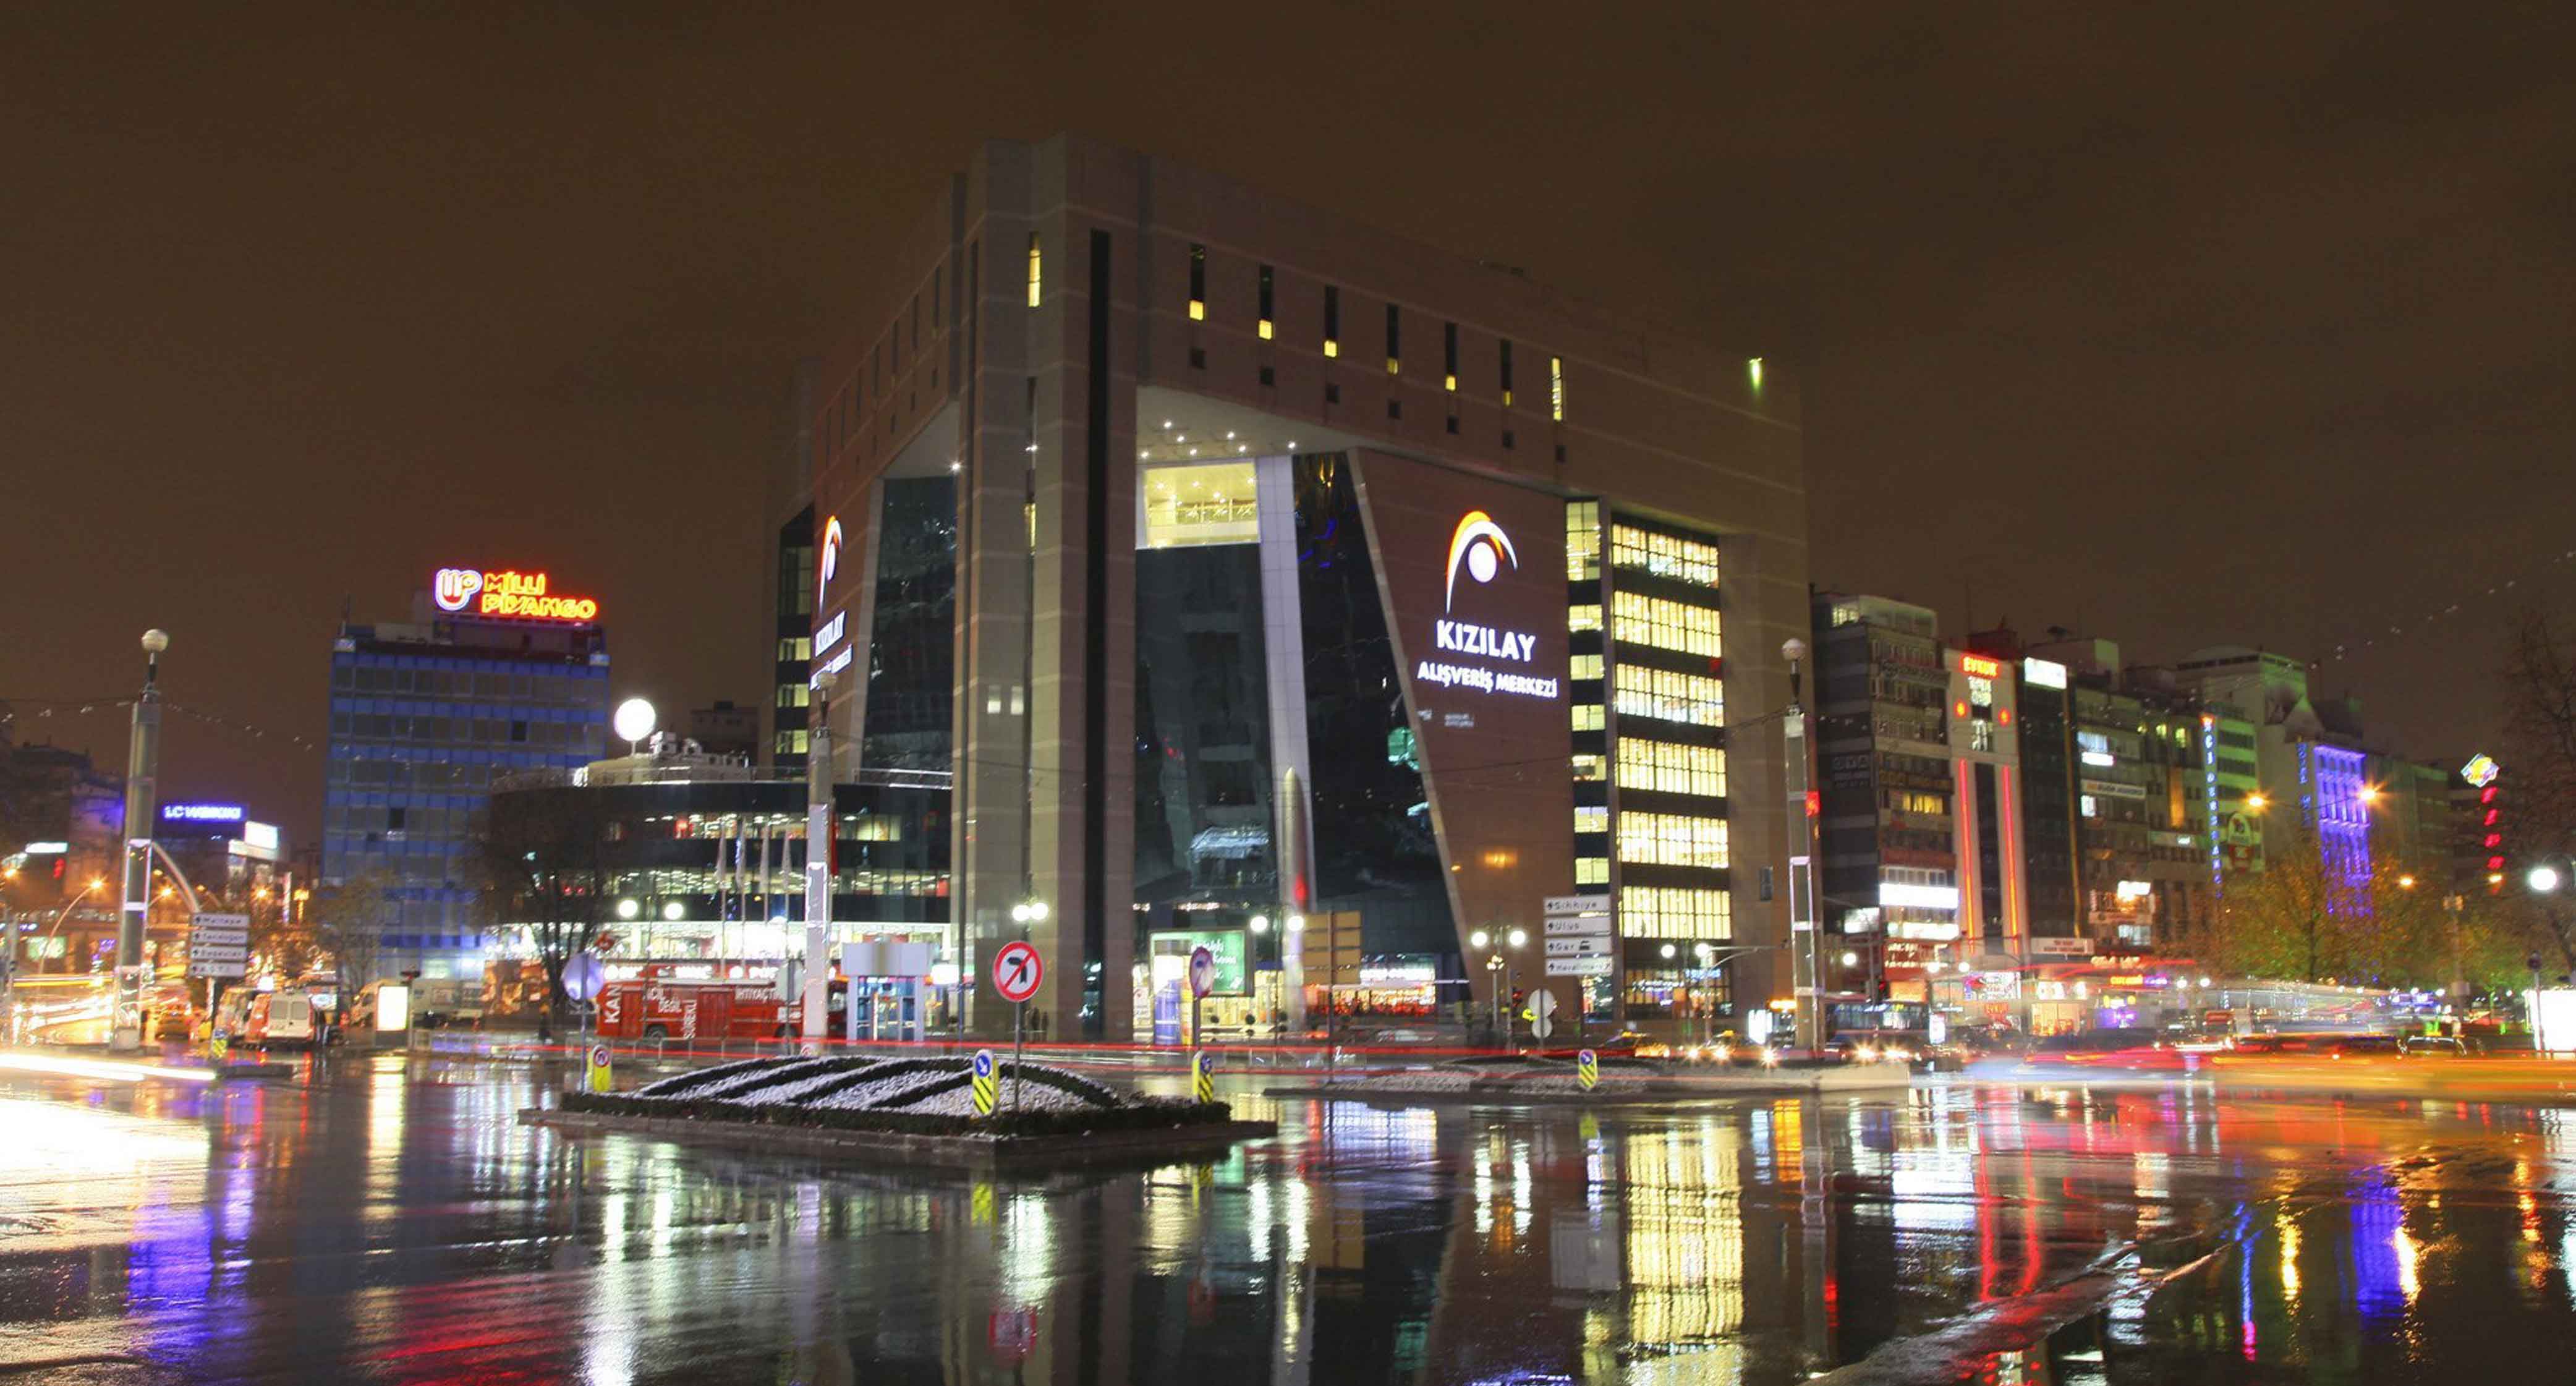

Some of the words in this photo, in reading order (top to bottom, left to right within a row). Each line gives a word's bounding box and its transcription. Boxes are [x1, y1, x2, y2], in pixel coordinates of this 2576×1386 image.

[484, 571, 545, 596] MİLLİ
[482, 593, 597, 619] PİYANGO
[1436, 619, 1536, 662] KIZILAY
[1417, 661, 1494, 694] ALIŞVERİŞ
[1495, 672, 1558, 699] MERKEZİ
[604, 984, 621, 1024] KAN
